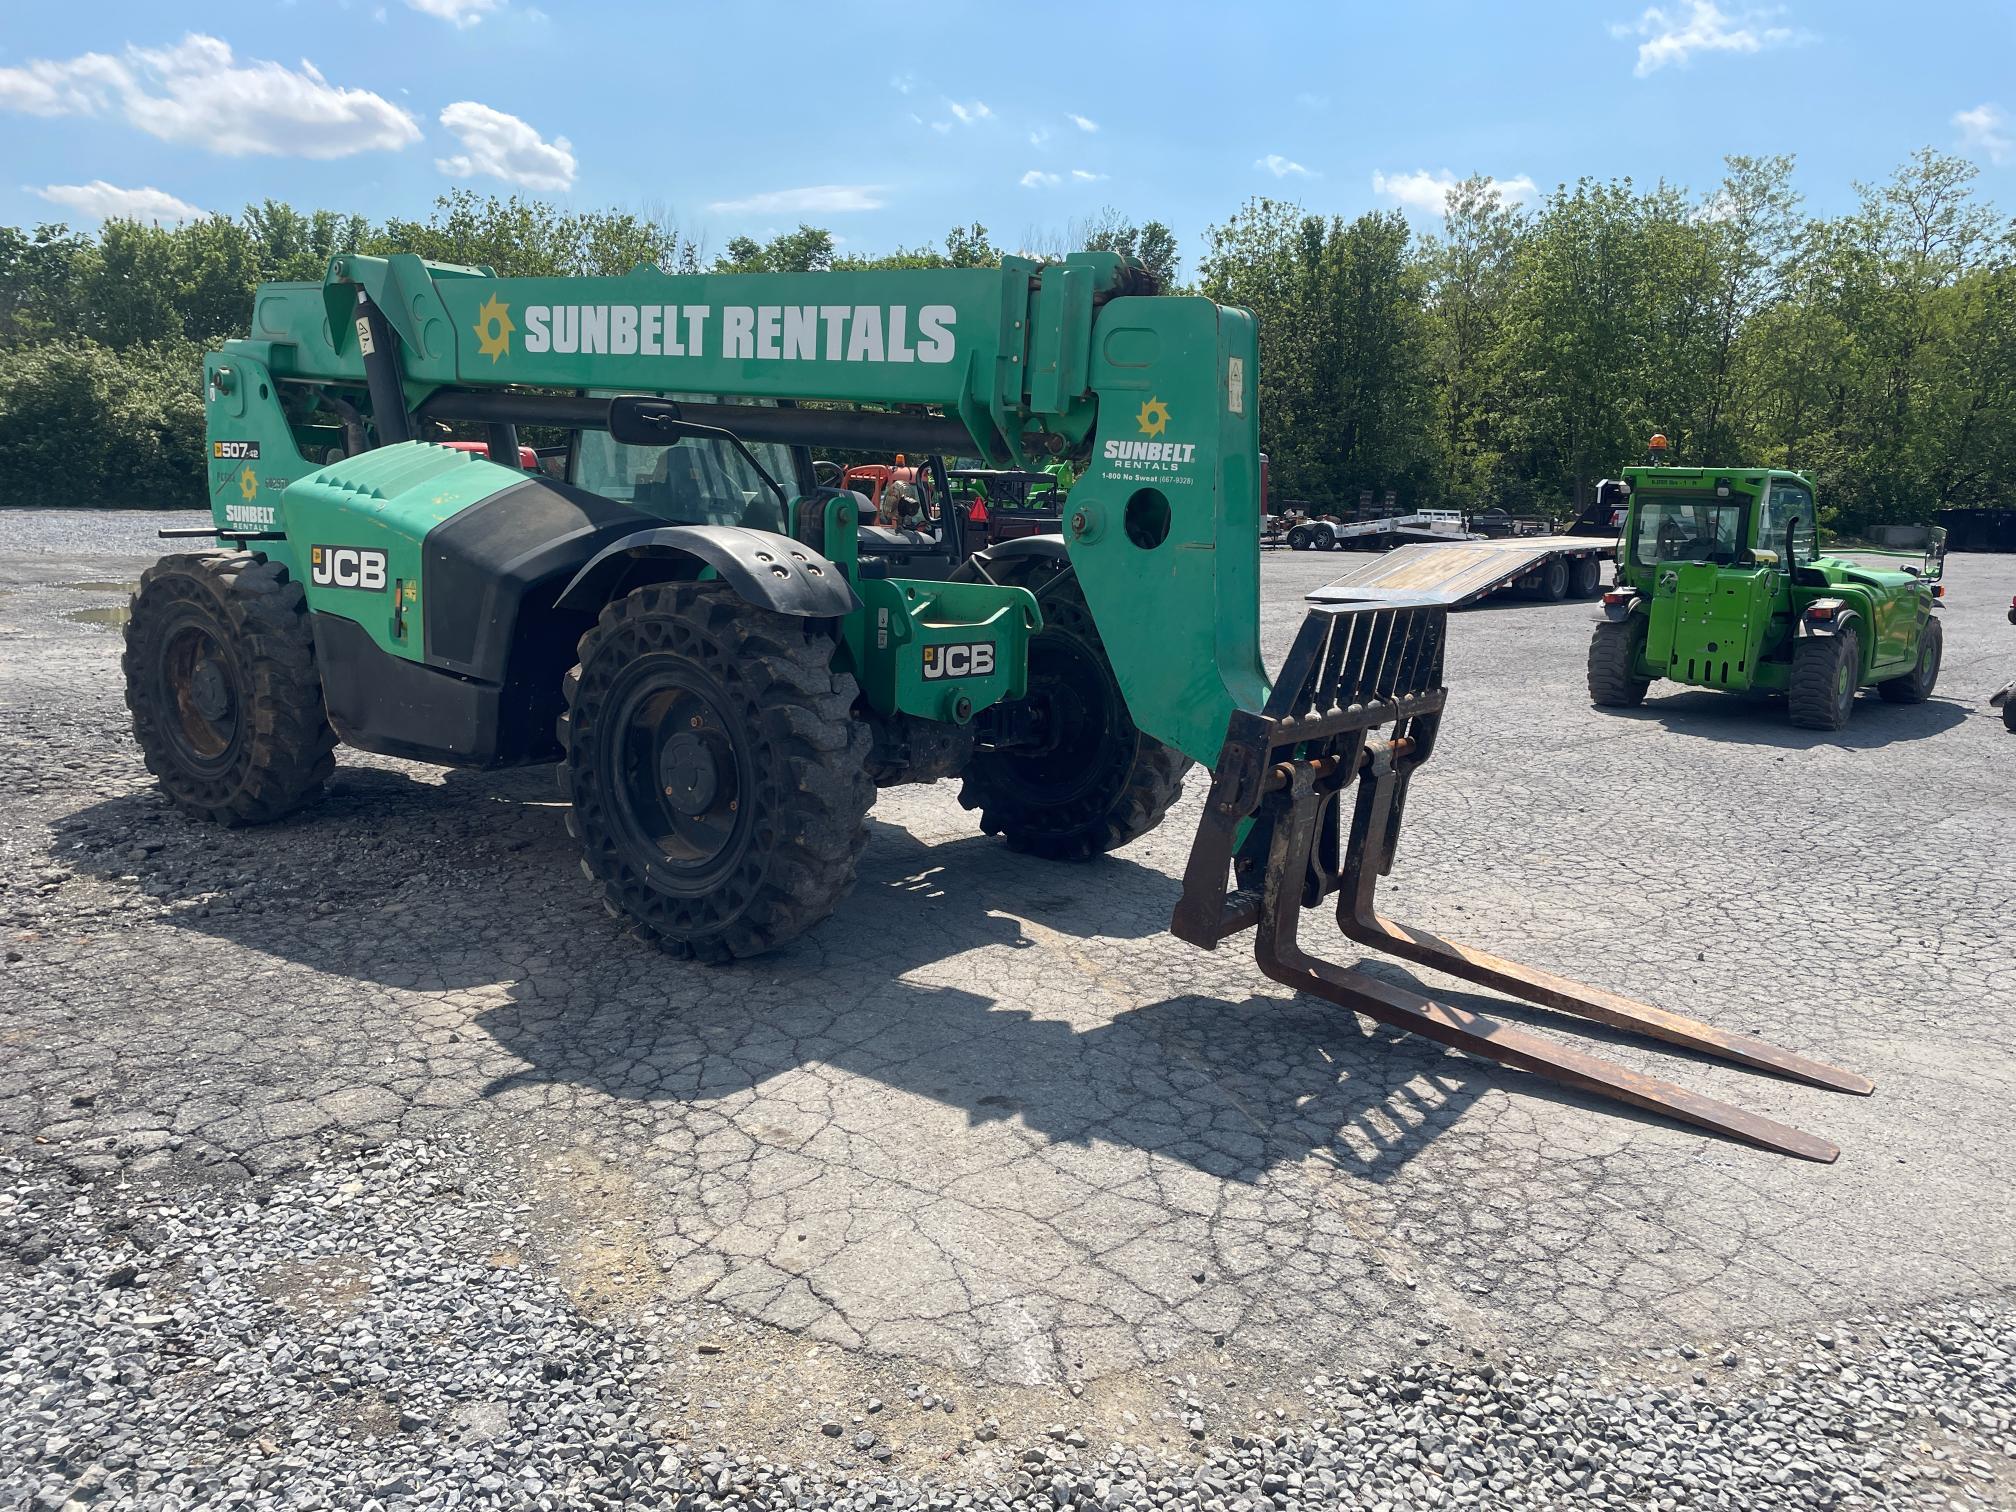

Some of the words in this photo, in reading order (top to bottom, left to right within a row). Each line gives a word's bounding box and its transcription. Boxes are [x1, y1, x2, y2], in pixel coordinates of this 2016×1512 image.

[524, 305, 710, 357] SUNBELT
[722, 305, 957, 363] RENTALS
[1103, 440, 1196, 463] SUNBELT
[1114, 460, 1179, 471] RENTALS
[1102, 472, 1121, 480] 1-800
[1123, 473, 1133, 481] No
[1134, 474, 1158, 483] Sweat
[226, 504, 275, 523] SUNBELT
[233, 523, 268, 531] RENTALS
[313, 549, 385, 588] JCB
[924, 644, 993, 677] JCB
